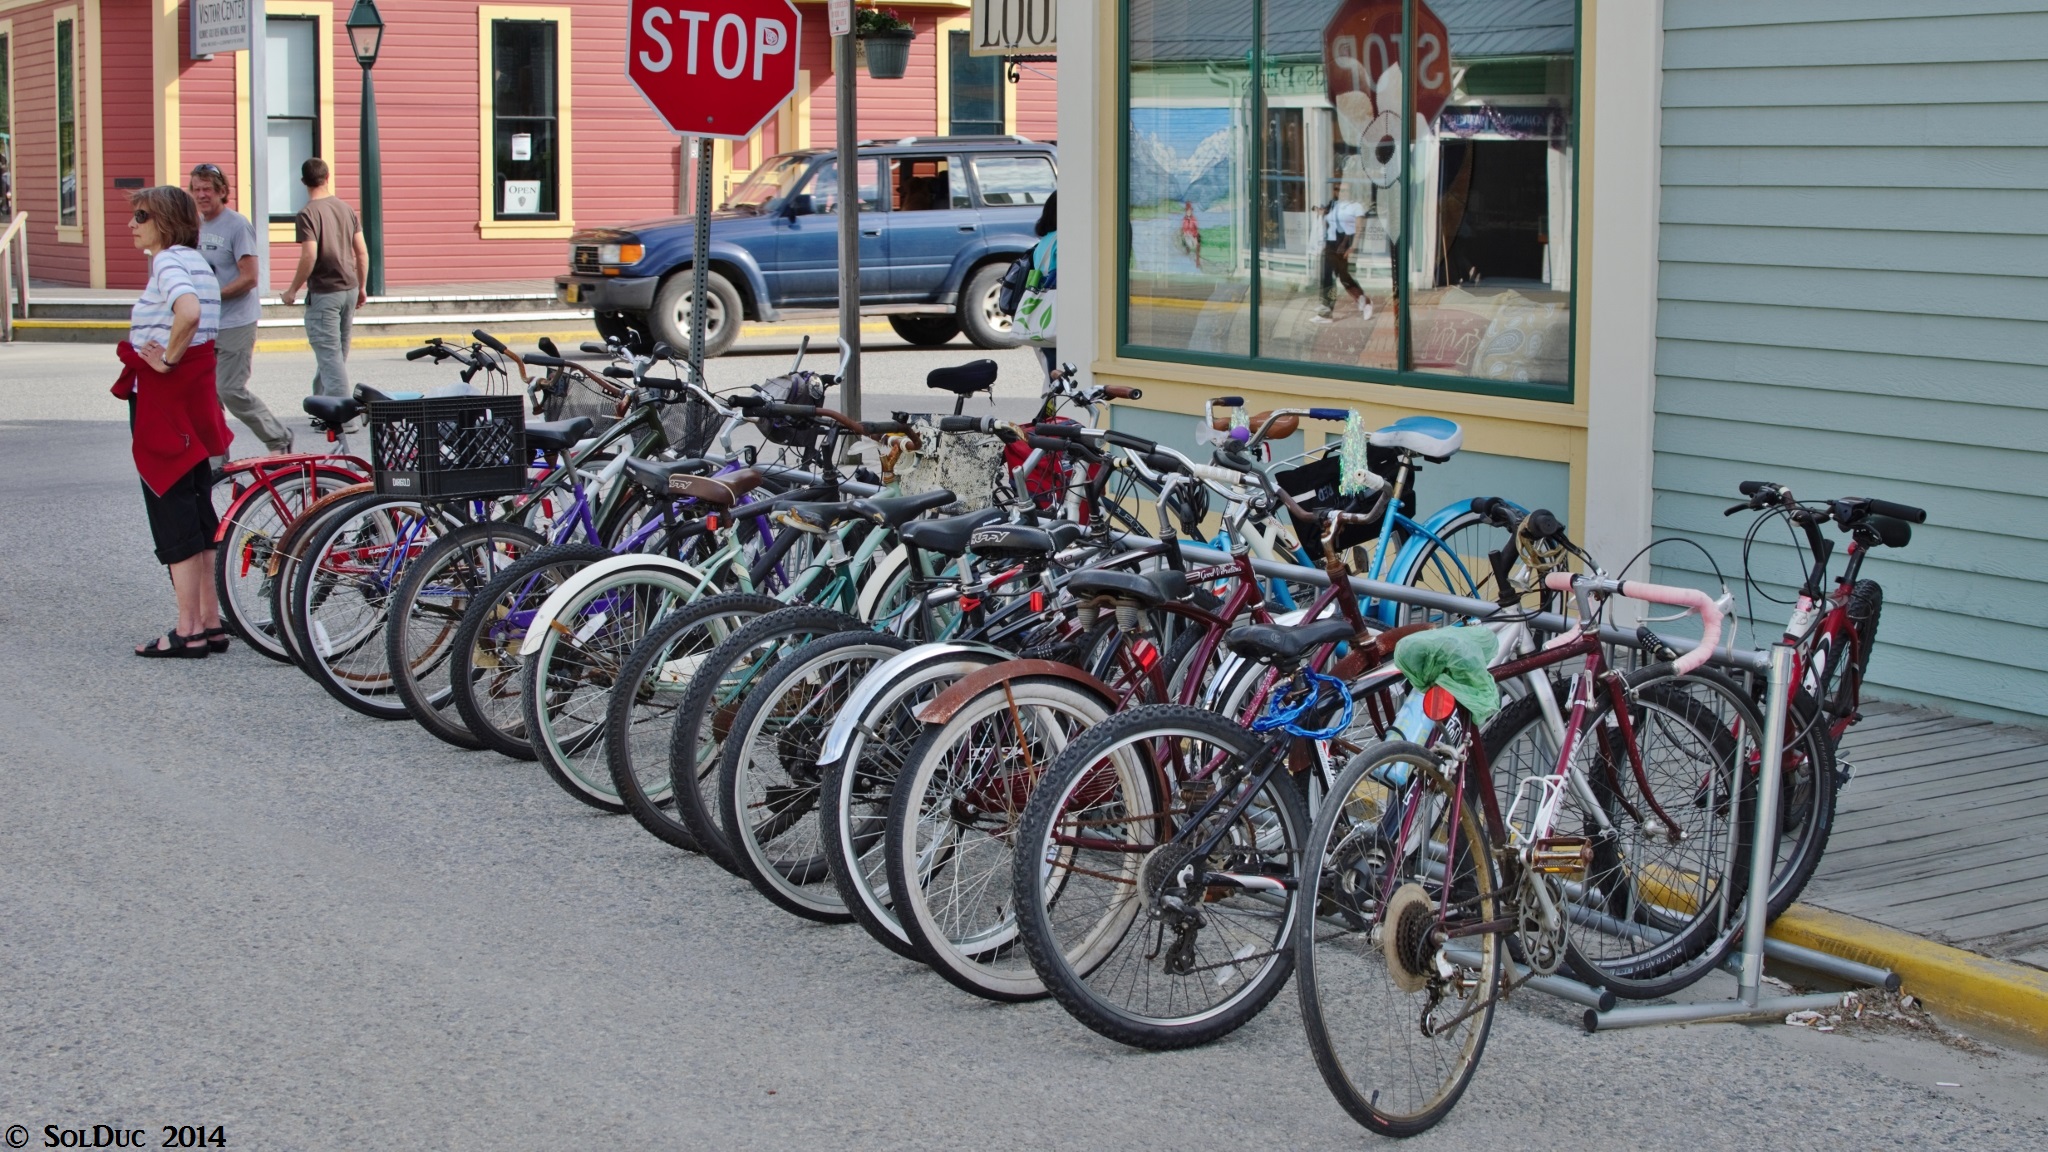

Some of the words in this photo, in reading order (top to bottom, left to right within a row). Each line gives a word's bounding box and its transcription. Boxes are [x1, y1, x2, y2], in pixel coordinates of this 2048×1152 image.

[980, 0, 1056, 48] LOO
[639, 6, 788, 81] STOP
[508, 185, 537, 195] OPEN
[669, 479, 693, 490] UFFY
